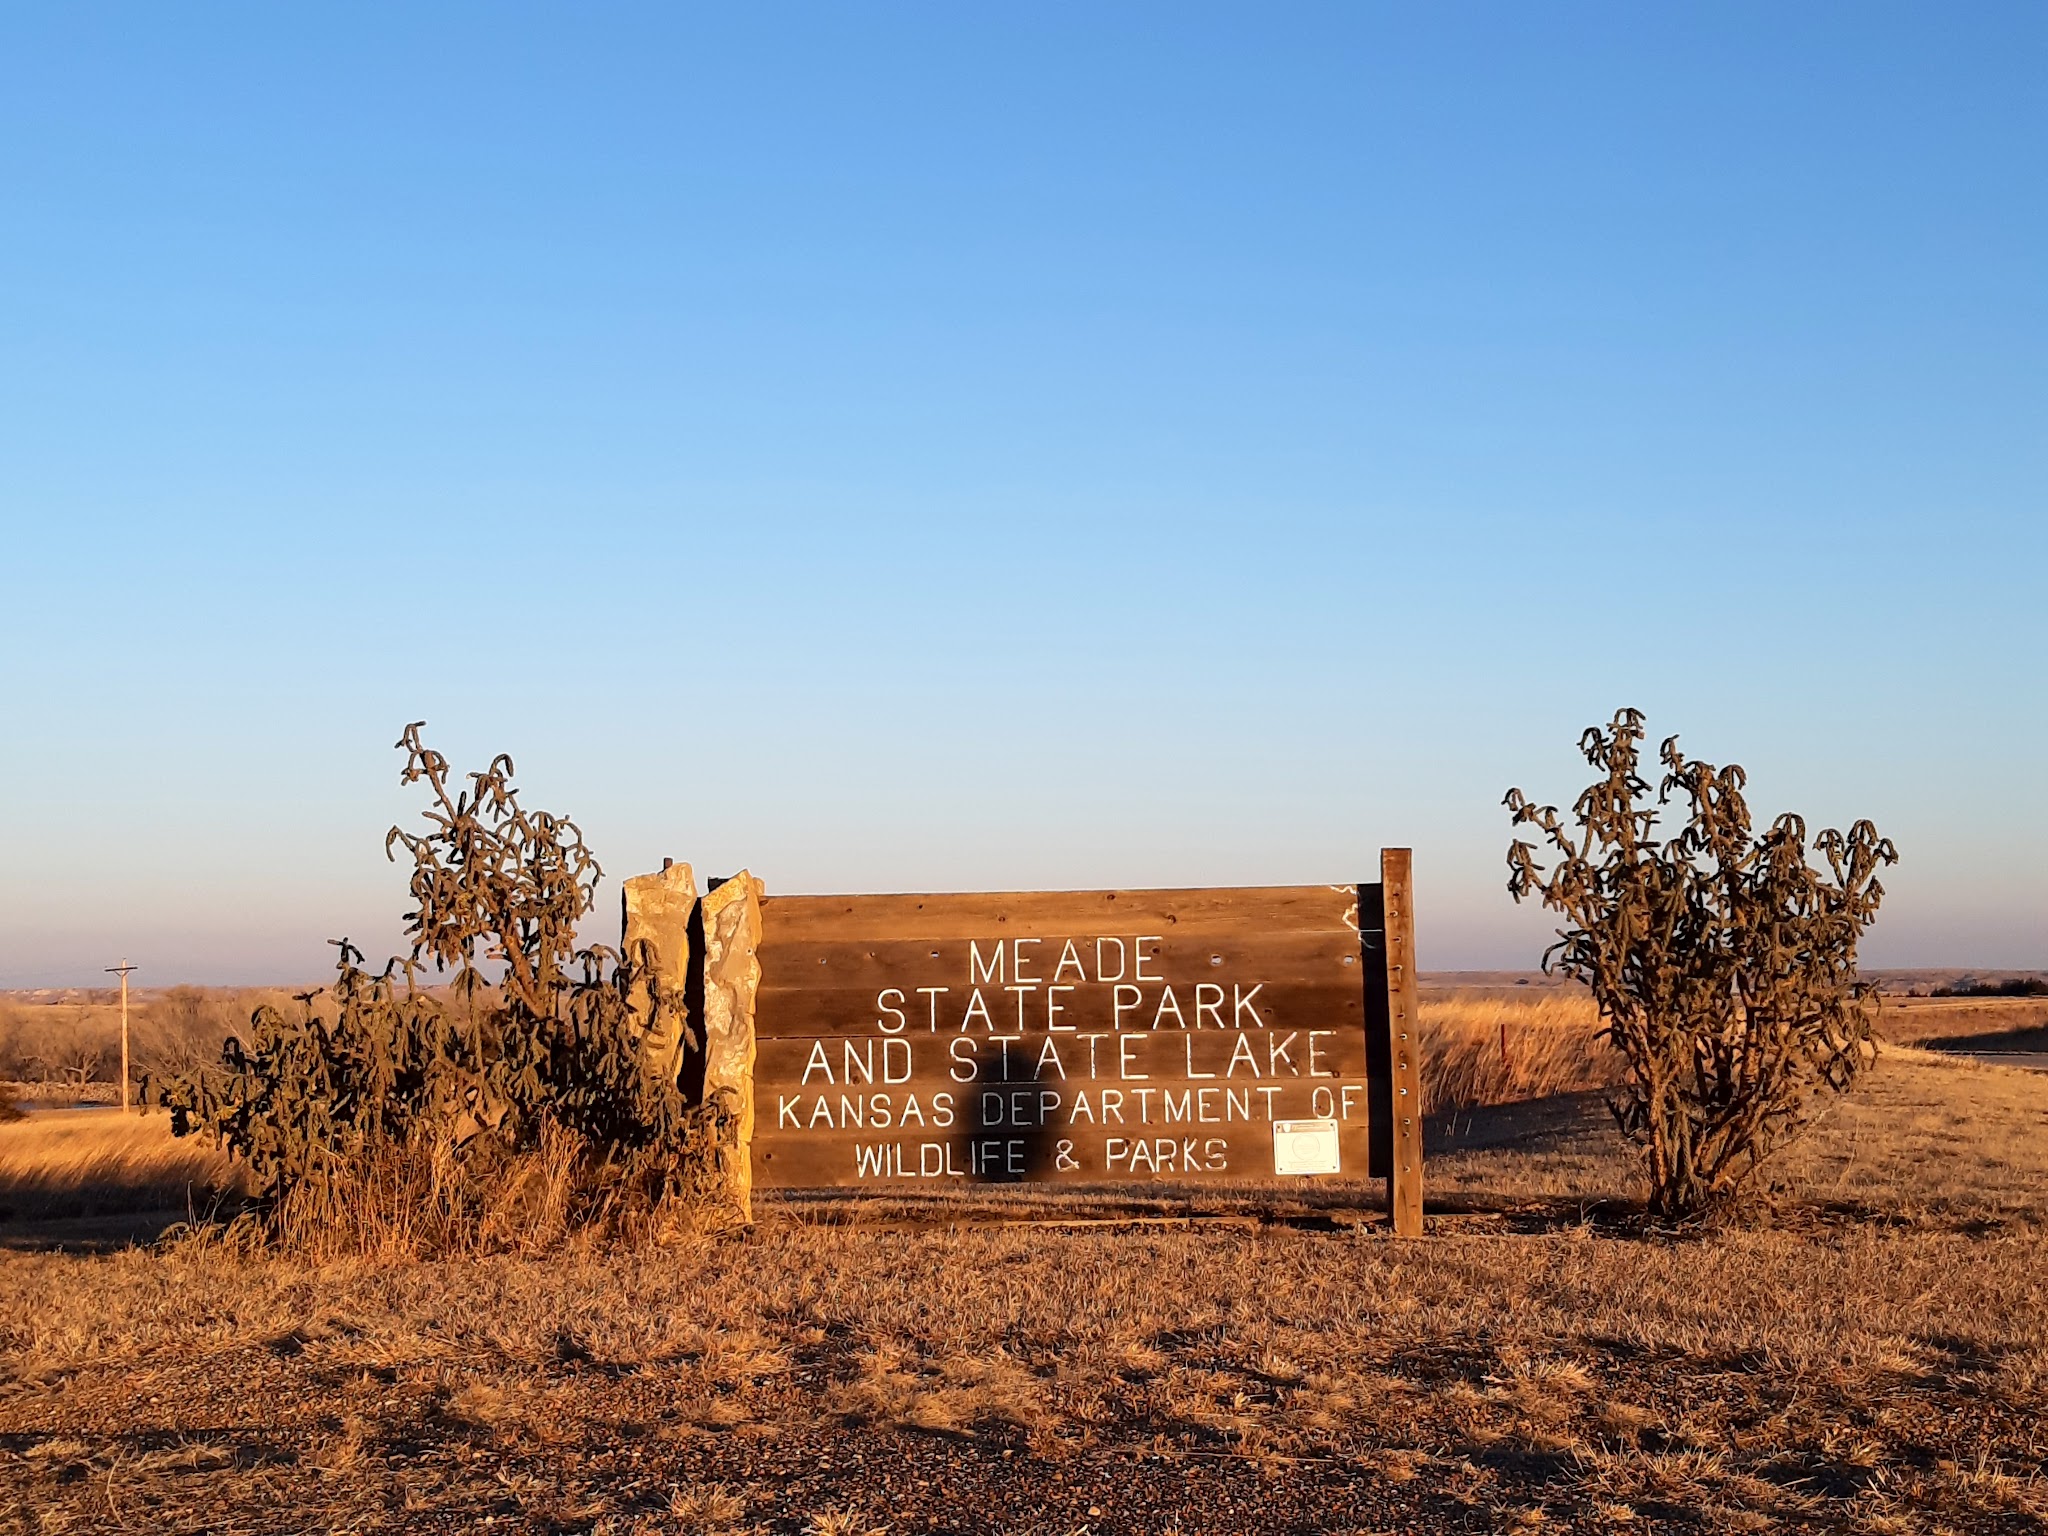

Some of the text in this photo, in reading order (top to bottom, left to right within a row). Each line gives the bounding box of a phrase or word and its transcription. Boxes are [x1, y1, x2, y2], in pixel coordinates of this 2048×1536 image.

[969, 936, 1164, 984] MEADE
[877, 983, 1266, 1034] STATE PARK
[800, 1030, 1337, 1086] AND STATE LAKE
[778, 1085, 1363, 1130] KANSAS DEPARTMENT OF
[856, 1137, 1228, 1178] WILDLIFE & PARKS
